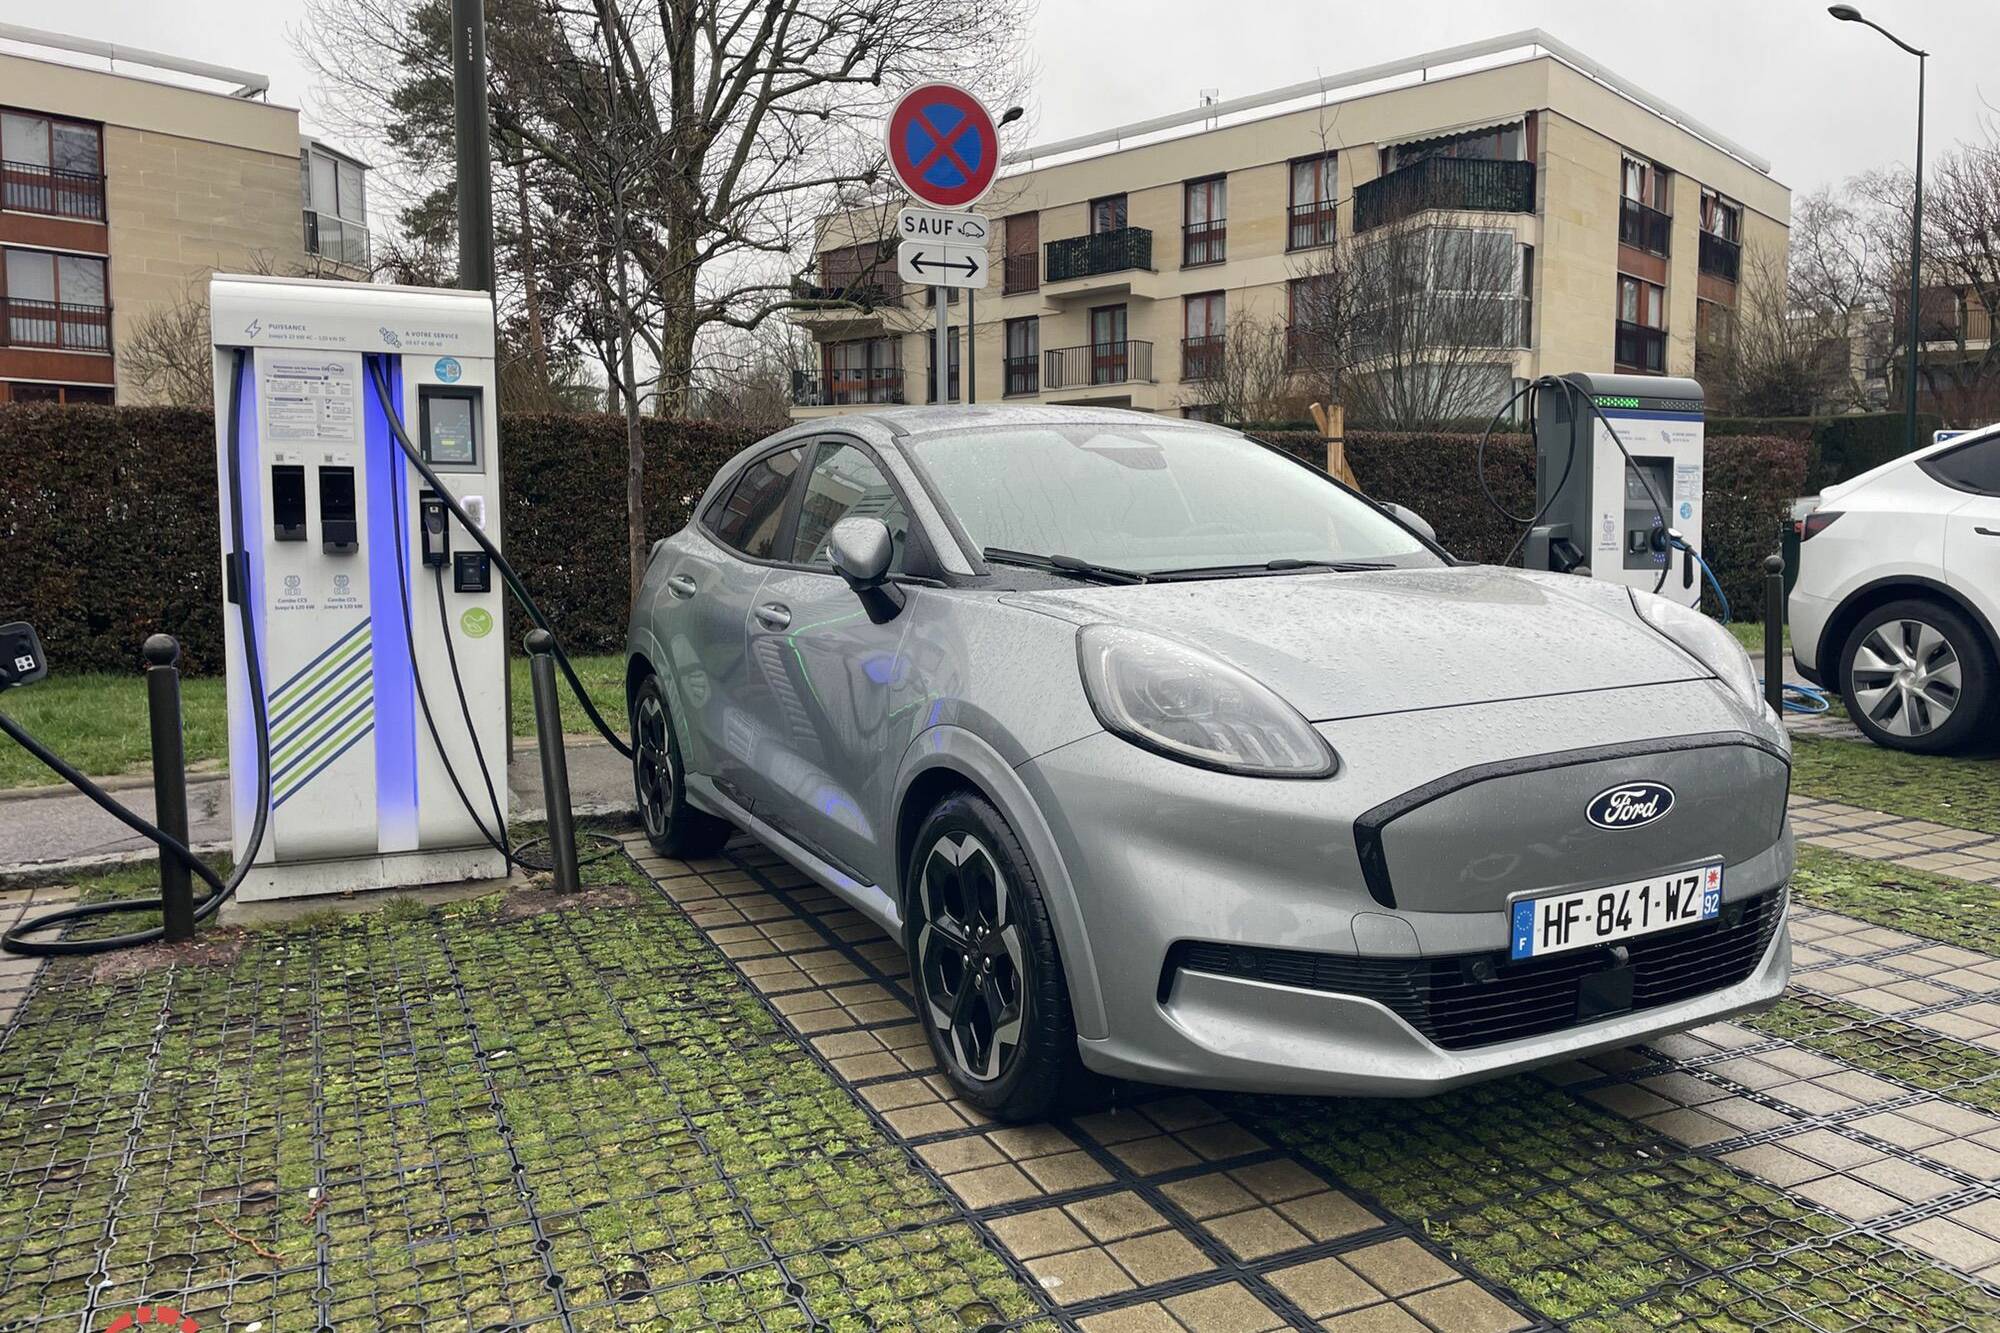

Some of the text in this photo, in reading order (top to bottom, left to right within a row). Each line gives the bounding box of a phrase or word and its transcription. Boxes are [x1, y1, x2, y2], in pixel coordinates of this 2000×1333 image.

[905, 216, 953, 235] SAUF
[268, 323, 306, 331] PUISSANCE
[1604, 789, 1660, 823] Ford
[1543, 876, 1699, 948] HF-841-WZ
[1704, 893, 1719, 914] 92
[1519, 938, 1527, 951] F
